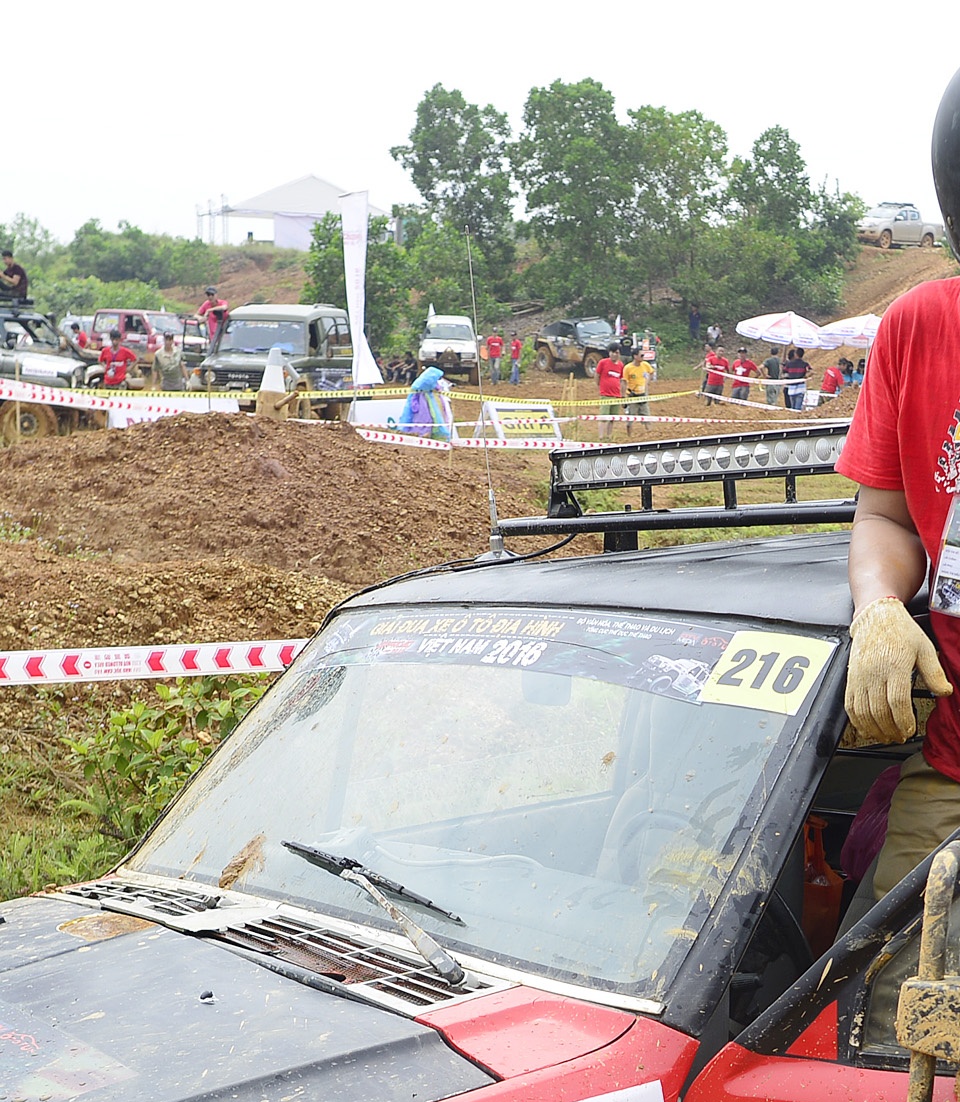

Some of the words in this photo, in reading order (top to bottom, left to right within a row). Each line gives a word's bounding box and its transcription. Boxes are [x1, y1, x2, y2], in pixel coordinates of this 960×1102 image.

[428, 618, 455, 634] XE
[468, 613, 496, 633] TÔ
[448, 638, 492, 655] NAM
[480, 639, 548, 667] 2016
[716, 648, 811, 694] 216
